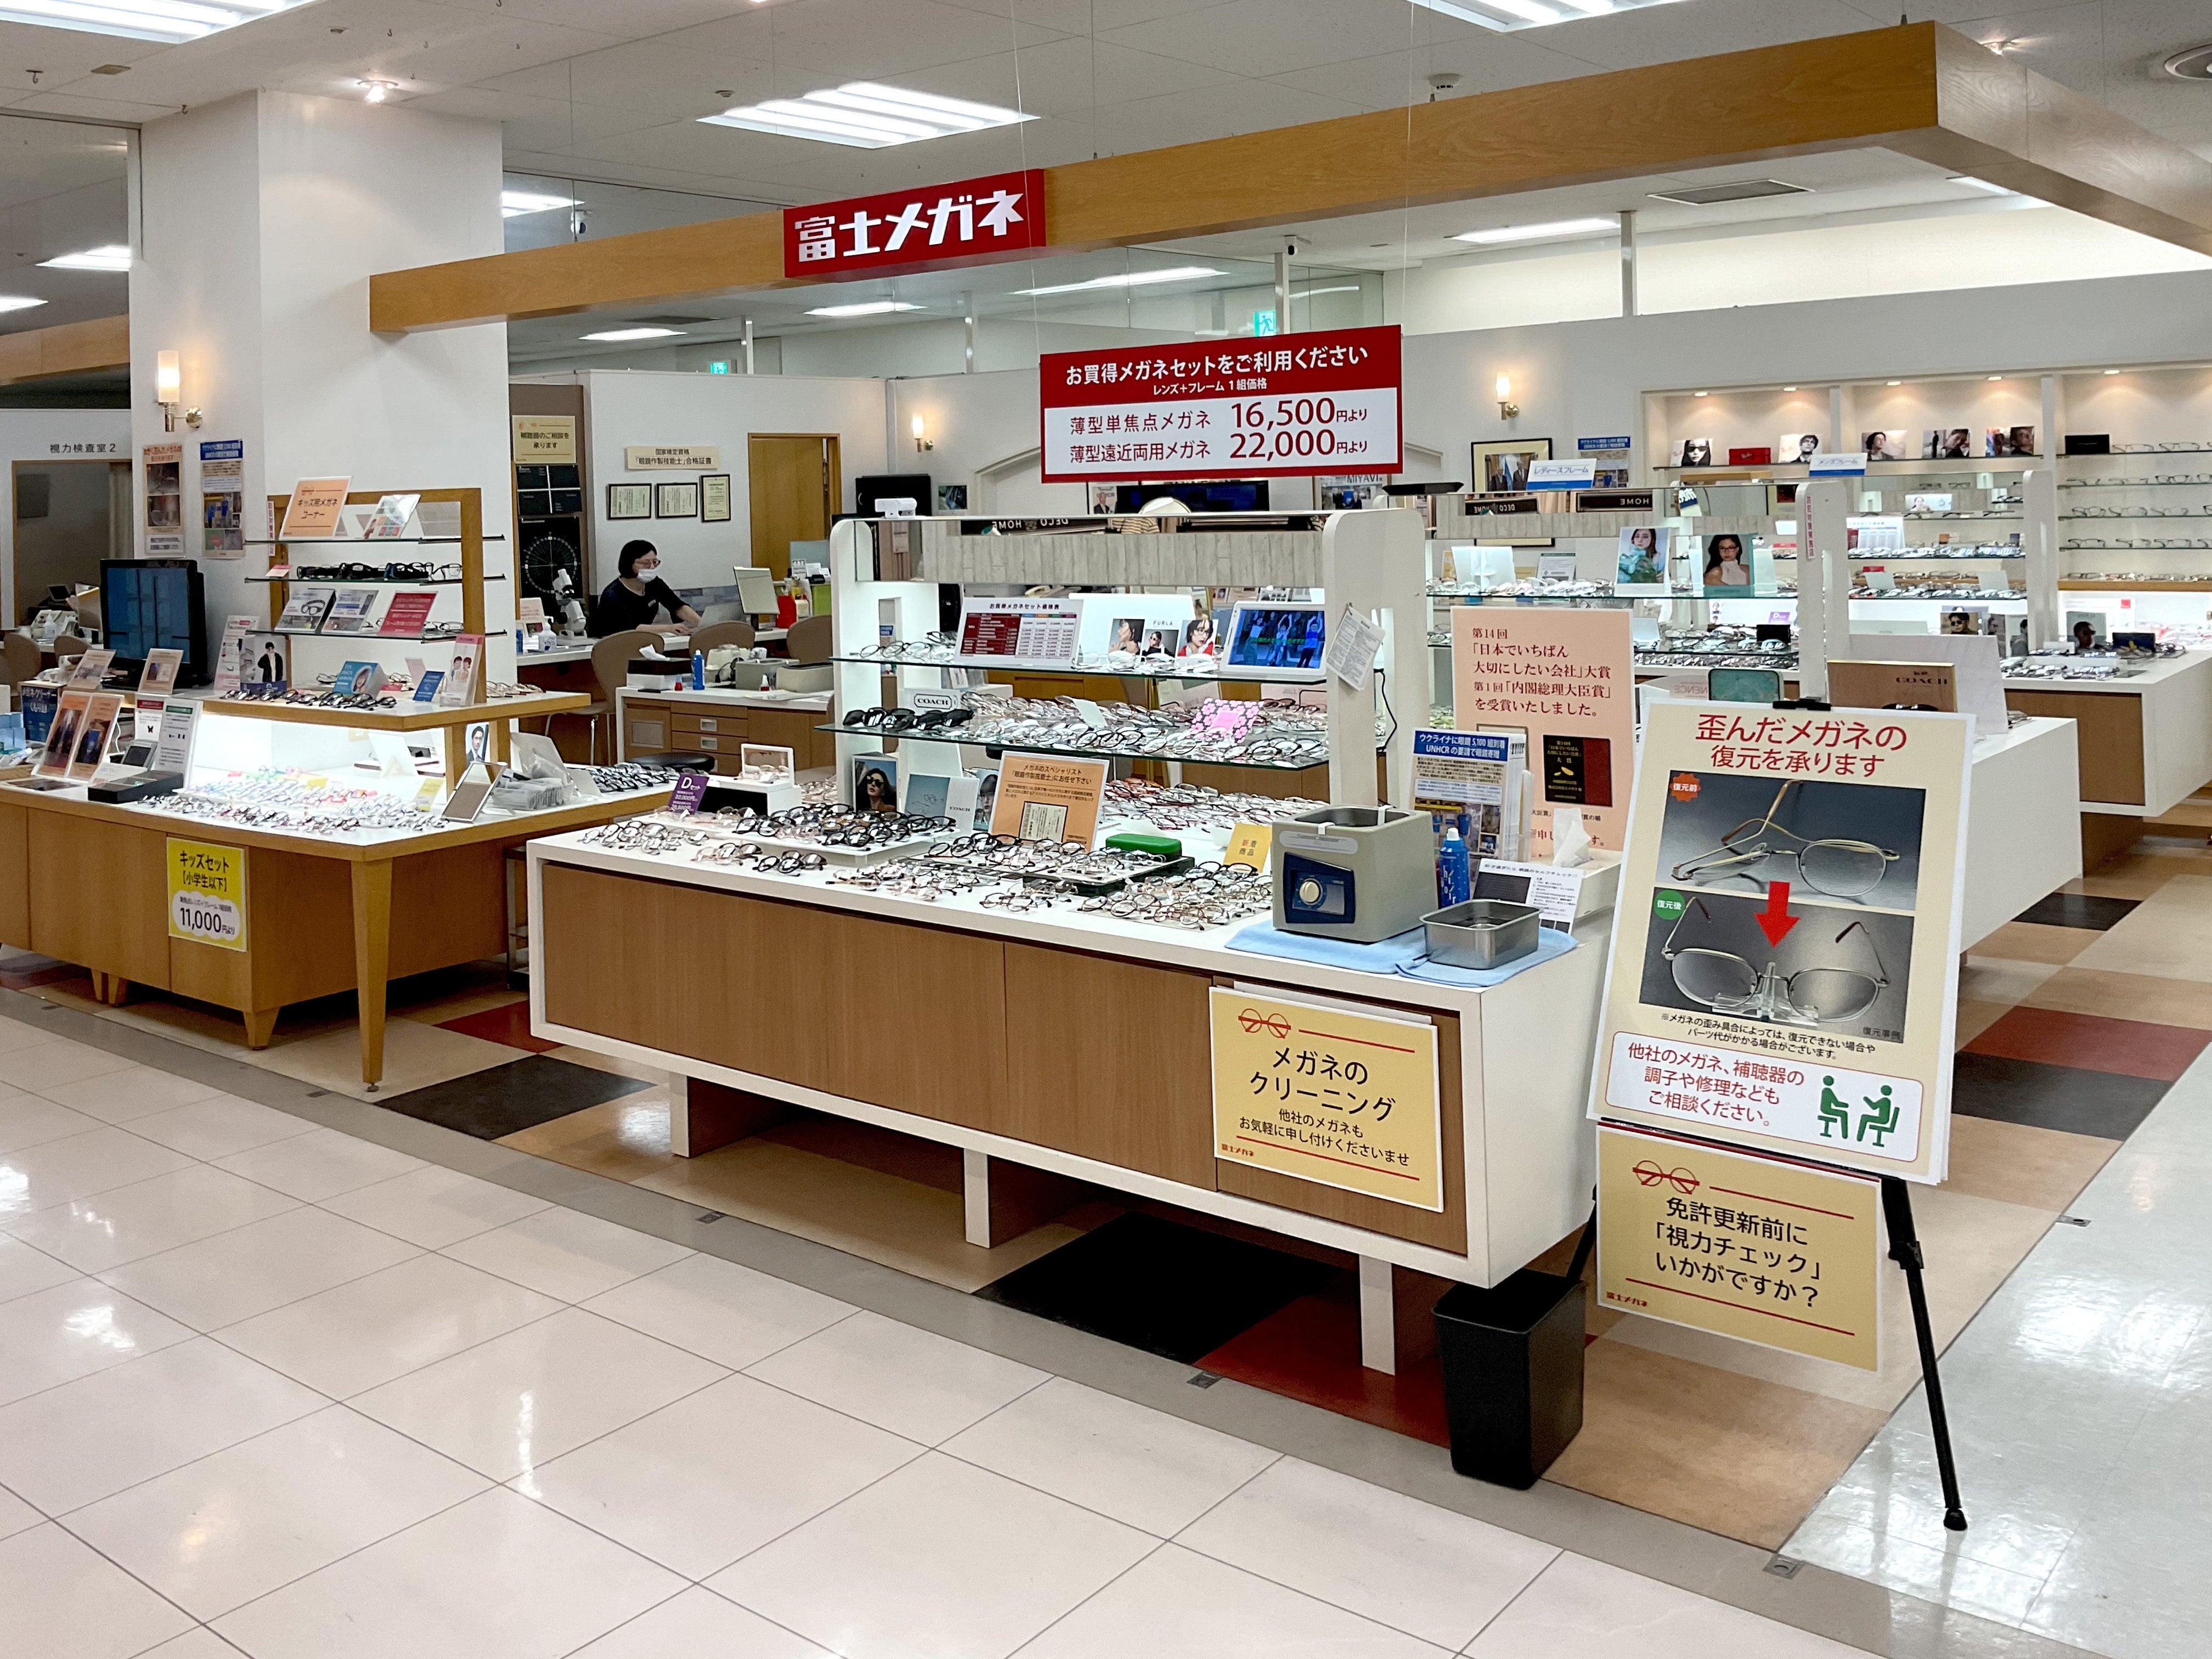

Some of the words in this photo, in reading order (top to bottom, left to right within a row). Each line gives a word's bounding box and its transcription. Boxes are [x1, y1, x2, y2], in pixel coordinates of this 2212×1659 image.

[794, 189, 1024, 262] 富士メガネ
[1066, 345, 1368, 386] お買得メガネセットをご利用ください
[1070, 410, 1211, 435] 薄型単焦点メガネ
[1231, 397, 1368, 431] 16,500円より
[1070, 441, 1211, 464] 薄型遠近両用メガネ
[1229, 429, 1368, 461] 22,000円より
[1534, 466, 1588, 475] レディースフレーム
[297, 498, 337, 507] キッズ用メガネ
[1472, 627, 1508, 639] 第14回
[1472, 642, 1569, 658] 「日本でいちばん
[1473, 662, 1611, 679] 大切にしたい会社」大賞
[1475, 698, 1597, 717] を受賞いたしました。
[1426, 745, 1449, 754] UNHCR
[1695, 714, 1907, 751] 歪んだメガネの
[1024, 764, 1082, 775] メガネのスペシャリスト
[1711, 744, 1884, 777] 復元を承ります
[1673, 782, 1698, 793] 復元前
[180, 850, 229, 873] キッズセット
[1657, 899, 1682, 911] 復元後
[1661, 1012, 1875, 1053] ※メガネの歪み具合によっては、復元できない場合や
[1688, 1027, 1836, 1059] パーツ代がかかる場合がございます。
[1273, 1047, 1368, 1085] メガネの
[1628, 1042, 1804, 1086] 他社のメガネ、補聴器の
[1250, 1071, 1396, 1122] クリーニング
[1645, 1066, 1780, 1105] 調子や修理なども
[1279, 1108, 1363, 1138] 他社のメガネも
[1648, 1090, 1770, 1127] ご相談ください。
[1239, 1116, 1409, 1167] お気軽に申し付けくださいませ
[1666, 1197, 1808, 1245] 免許更新前に
[1656, 1222, 1820, 1280] 「視力チェック」
[1656, 1252, 1819, 1307] いかがですか？
